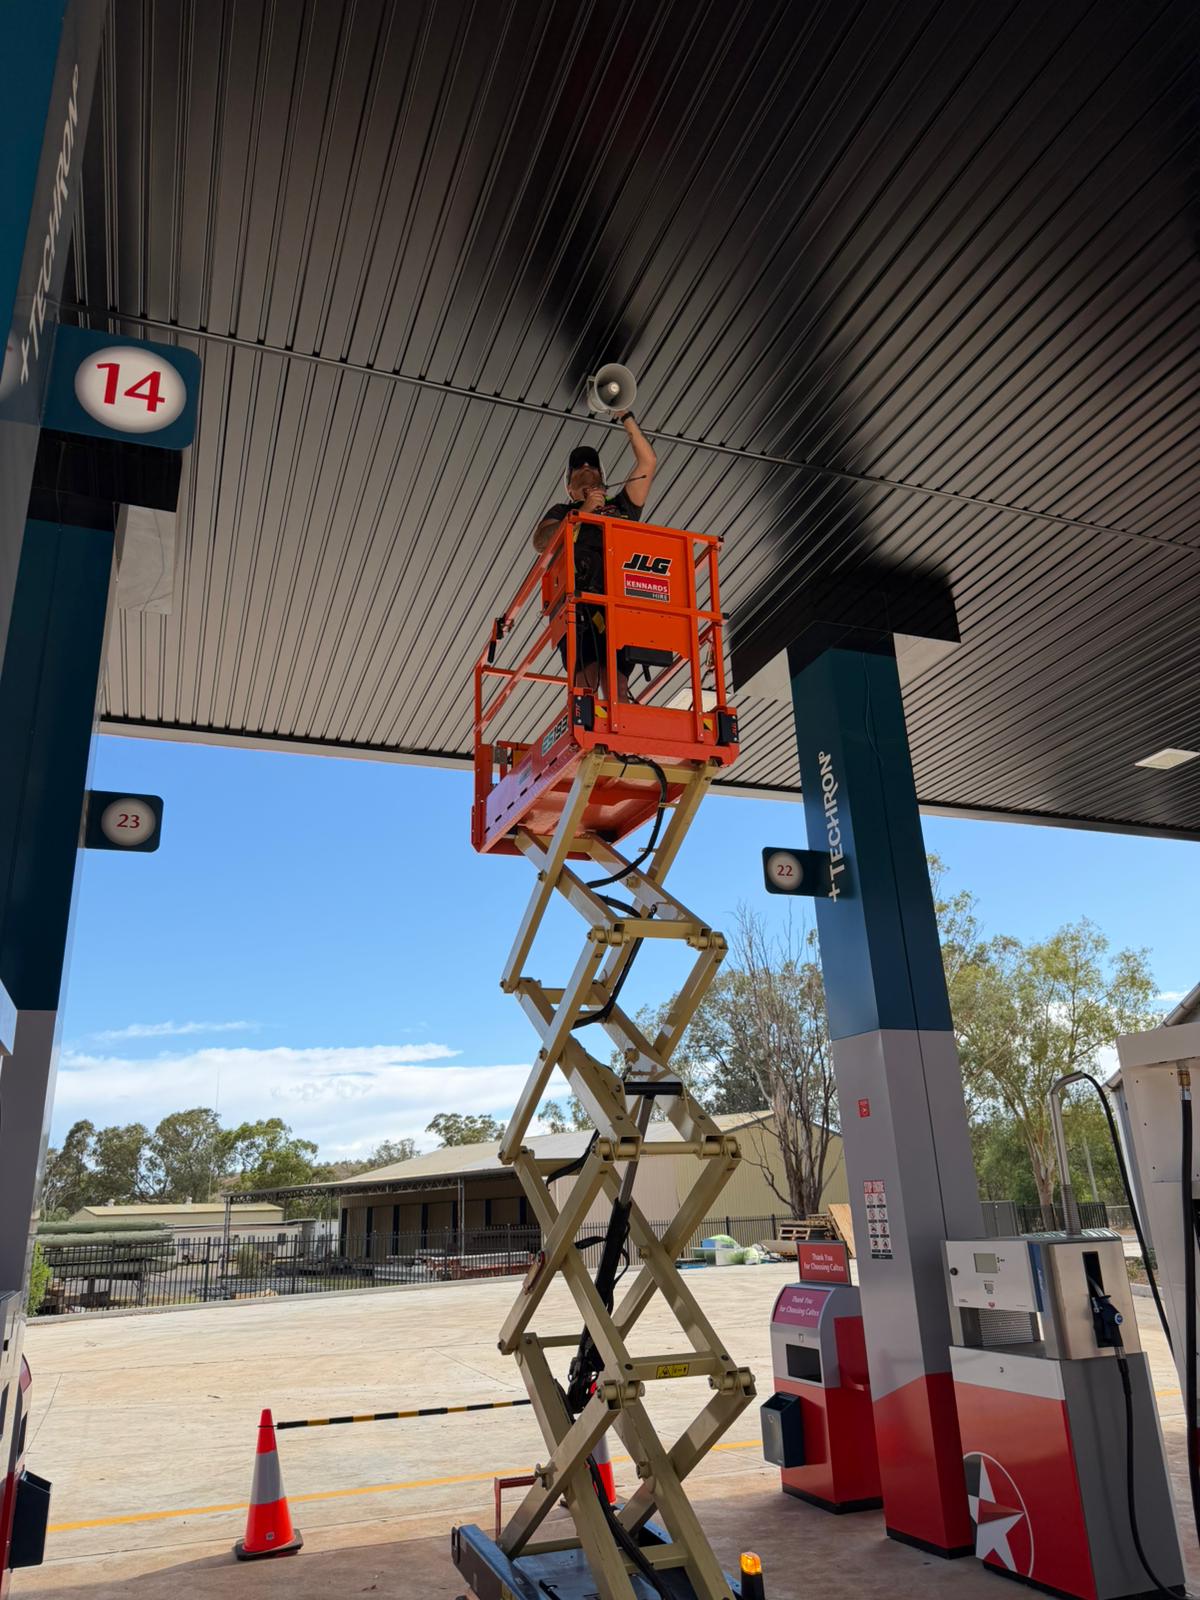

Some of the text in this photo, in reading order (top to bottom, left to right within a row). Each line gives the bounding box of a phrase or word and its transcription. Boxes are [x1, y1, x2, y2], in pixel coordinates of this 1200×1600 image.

[96, 363, 166, 412] 14
[623, 553, 672, 575] JLG
[626, 580, 668, 593] KENNARDS
[116, 813, 141, 829] 23
[776, 864, 793, 877] 22
[811, 1253, 824, 1261] Thank
[811, 1263, 830, 1273] Choosing
